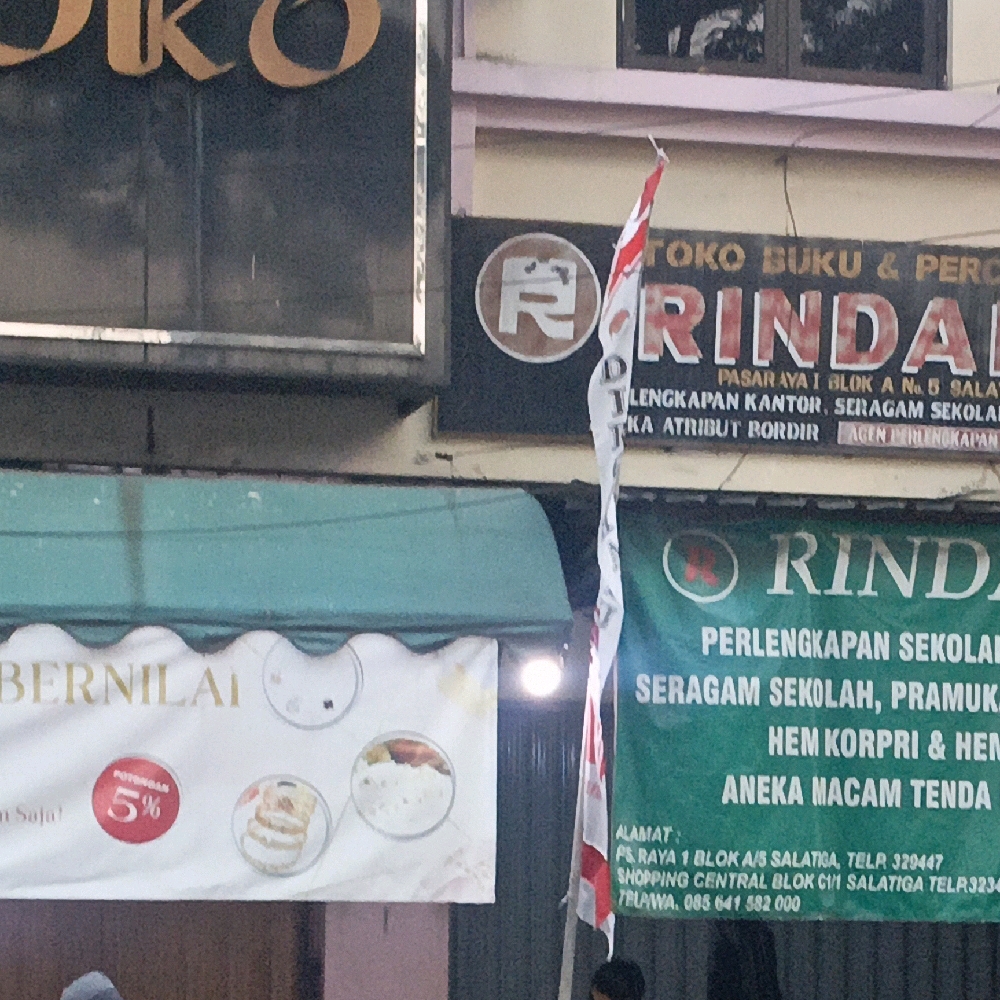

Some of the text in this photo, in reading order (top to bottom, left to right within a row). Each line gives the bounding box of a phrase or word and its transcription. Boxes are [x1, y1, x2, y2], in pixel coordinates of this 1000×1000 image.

[644, 239, 745, 272] TOKO
[762, 245, 862, 279] BUKU
[877, 251, 899, 281] &
[828, 375, 873, 393] BLOK
[881, 376, 894, 394] A
[834, 396, 923, 419] SERAGAM
[663, 416, 742, 439] ATRIBUT
[747, 420, 819, 441] BORDIR
[701, 625, 891, 661] PERLENGKAPAN
[634, 673, 760, 706] SERAGAM
[769, 676, 882, 715] SEKOLAH,
[768, 725, 819, 757] HEM
[824, 727, 919, 760] KORPRI
[928, 729, 946, 755] &
[721, 774, 804, 806] ANEKA
[811, 776, 902, 809] MACAM
[910, 779, 992, 811] TENDA
[638, 847, 676, 866] RAYA
[693, 849, 740, 868] BLOK
[616, 866, 690, 889] SHOPPING
[693, 870, 768, 890] CENTRAL
[771, 872, 815, 891] BLOK
[846, 874, 925, 893] SALATIGA
[774, 894, 801, 913] 000
